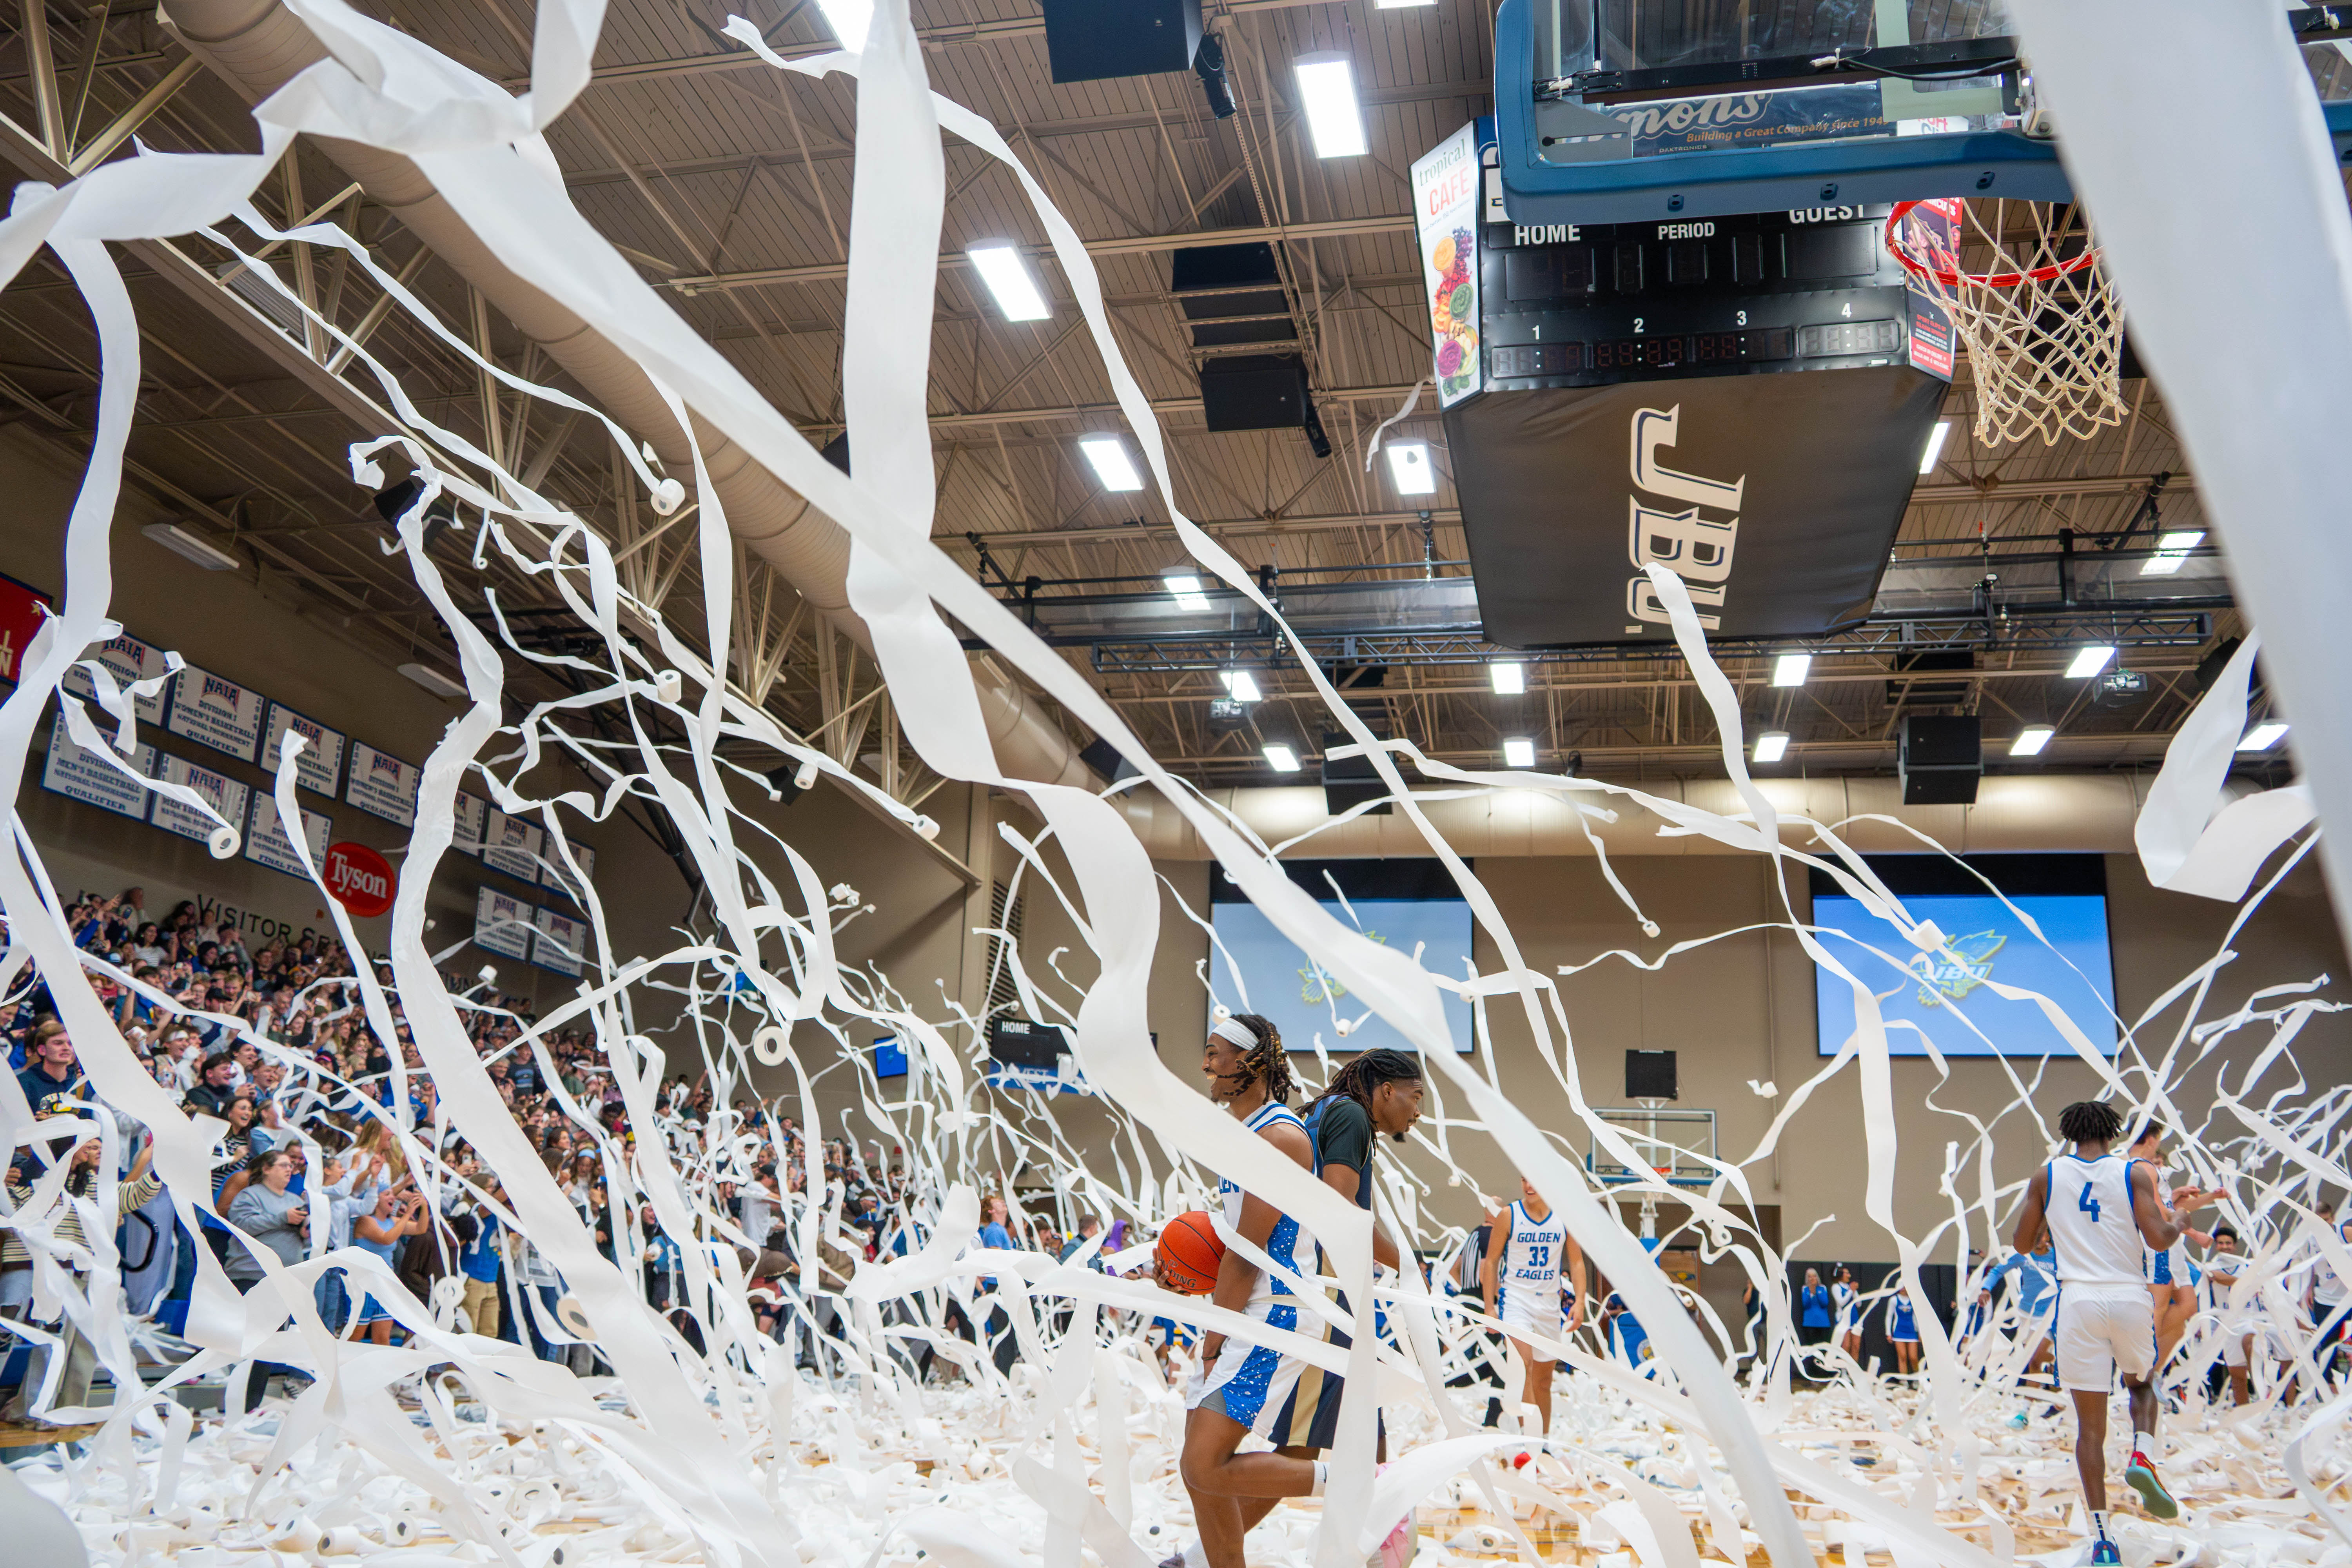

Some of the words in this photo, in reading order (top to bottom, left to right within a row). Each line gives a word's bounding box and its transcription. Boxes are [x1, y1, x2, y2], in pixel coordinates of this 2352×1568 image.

[1687, 127, 1732, 143] Building
[1744, 126, 1774, 138] Great
[1777, 122, 1830, 134] Company
[1831, 118, 1860, 129] since
[1659, 144, 1708, 154] DAKTRONICS
[1419, 138, 1466, 187] tropical
[1430, 166, 1471, 216] CAFE
[1789, 205, 1864, 224] GUEST
[1515, 225, 1581, 246] HOME
[1658, 221, 1715, 240] PERIOD
[1737, 311, 1747, 326] 3
[1842, 303, 1852, 318] 4
[1532, 325, 1541, 340] 1
[1634, 318, 1644, 333] 2
[1626, 403, 1746, 631] JBU
[103, 638, 143, 666] NAIA
[203, 676, 238, 707] NAIA
[186, 728, 239, 754] QUALIFIER
[292, 717, 322, 746] NAIA
[372, 754, 400, 783] NAIA
[65, 785, 127, 811] QUALIFIER
[330, 851, 387, 899] Tyson
[198, 894, 292, 942] VISITOR
[1001, 1021, 1031, 1034] HOME
[2079, 1182, 2101, 1222] 4
[1517, 1232, 1561, 1243] GOLDEN
[1528, 1246, 1549, 1267] 33
[1515, 1269, 1555, 1281] EAGLES
